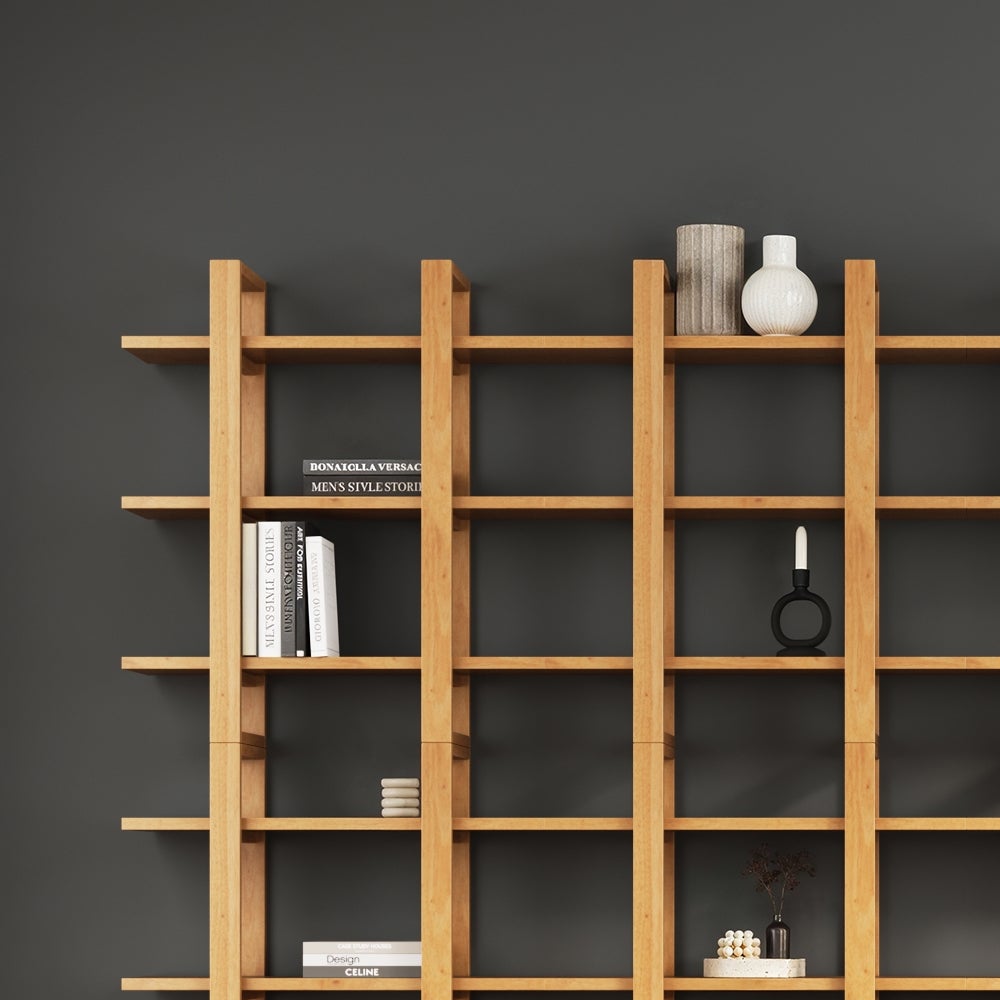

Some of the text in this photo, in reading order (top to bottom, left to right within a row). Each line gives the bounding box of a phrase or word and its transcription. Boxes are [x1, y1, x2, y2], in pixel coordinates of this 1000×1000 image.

[377, 462, 421, 472] VERSAC
[311, 481, 346, 492] MEN'S
[384, 481, 421, 492] STORI
[326, 954, 360, 965] Design
[344, 968, 379, 976] CELINE
